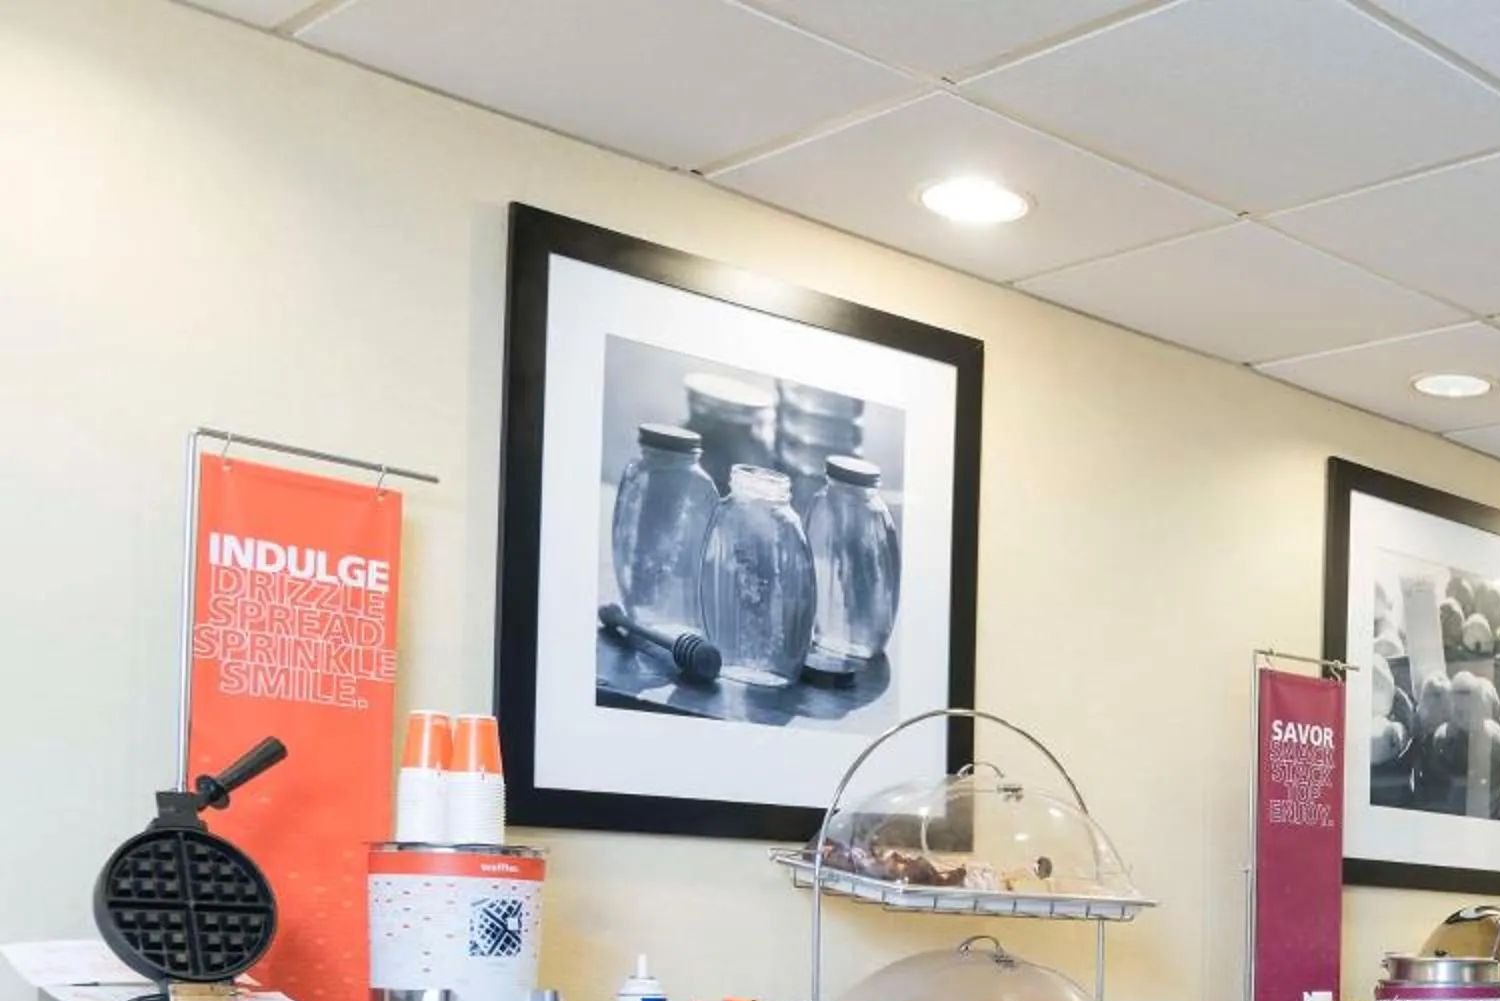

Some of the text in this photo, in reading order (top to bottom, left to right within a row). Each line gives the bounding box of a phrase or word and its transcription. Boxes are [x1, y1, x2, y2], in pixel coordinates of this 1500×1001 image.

[208, 531, 390, 592] INDULGE
[210, 564, 386, 620] DRIZZLE
[208, 597, 386, 647] SPREAD
[193, 624, 398, 682] SPRINKLE
[219, 661, 369, 709] SMILE.
[1271, 719, 1335, 748] SAVOR
